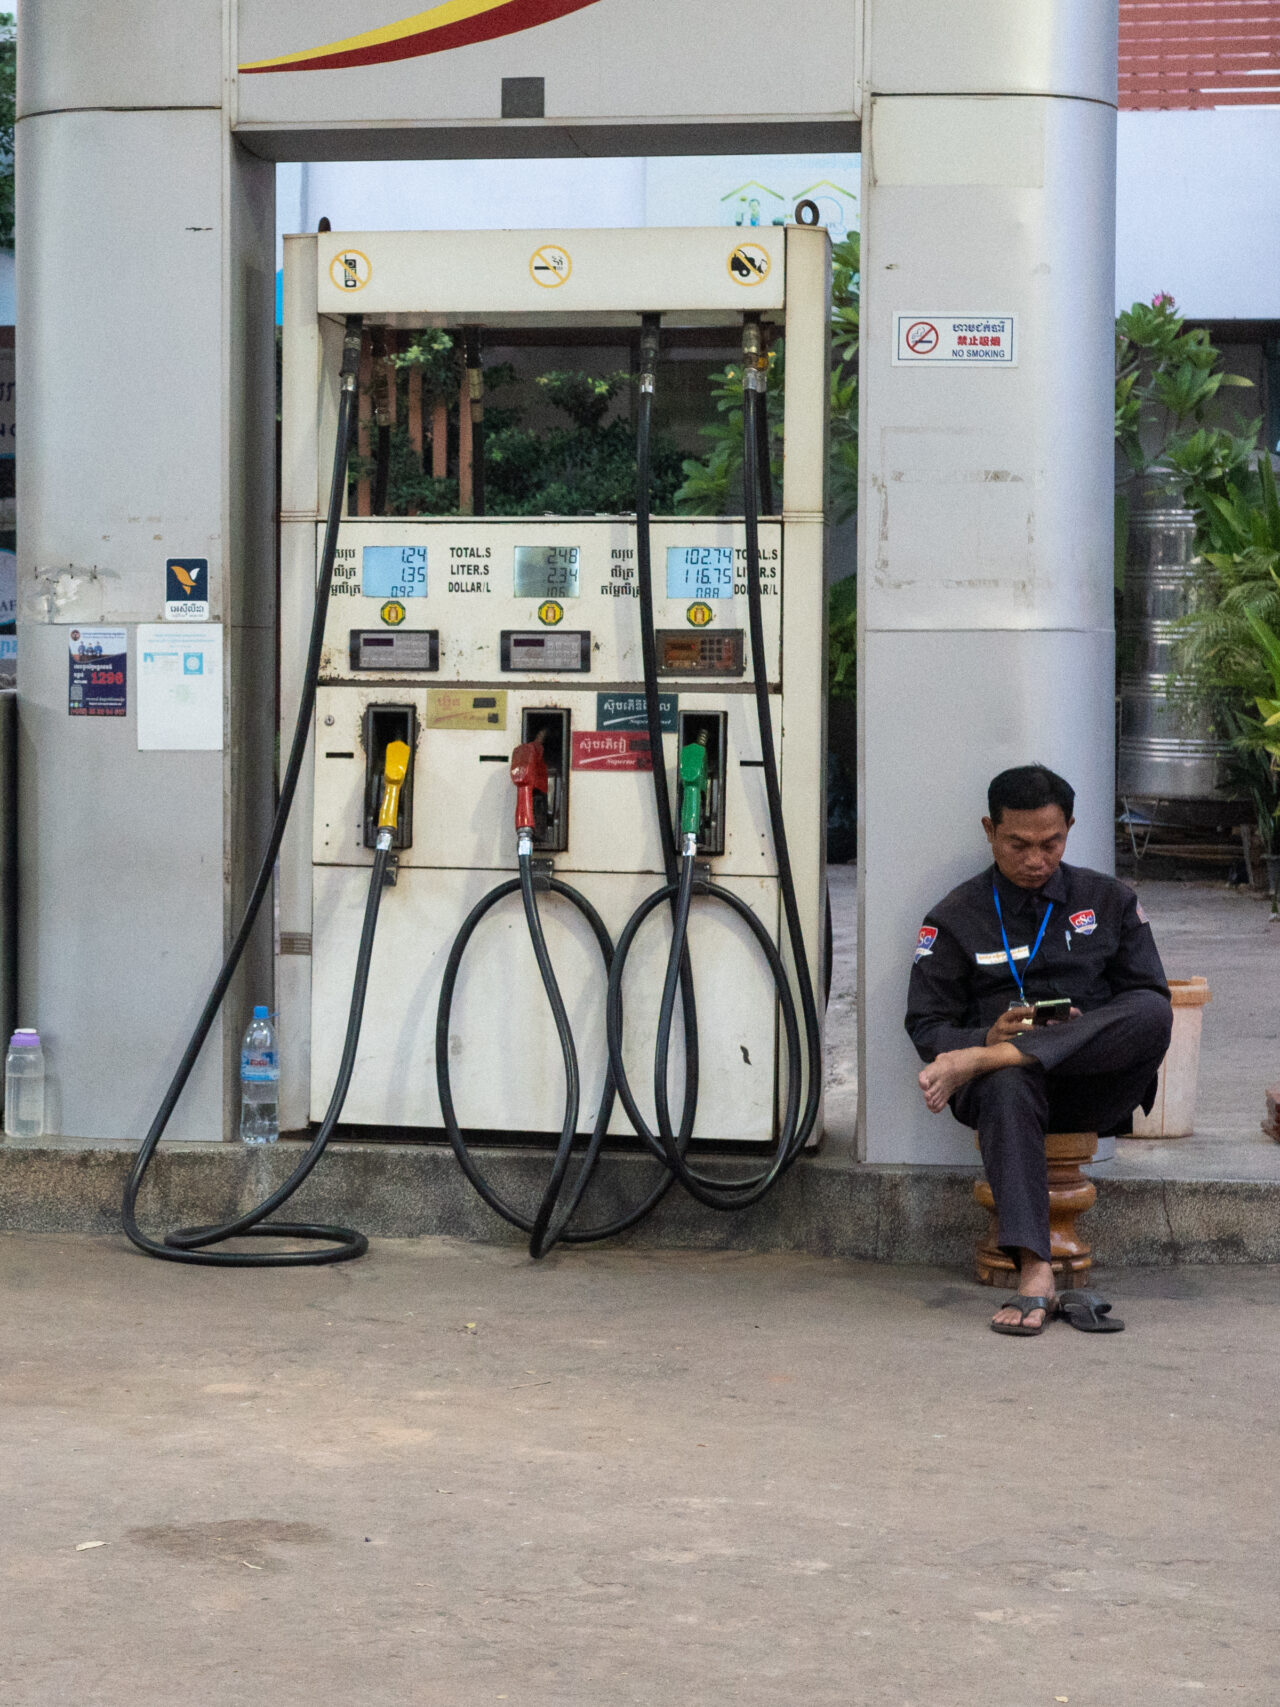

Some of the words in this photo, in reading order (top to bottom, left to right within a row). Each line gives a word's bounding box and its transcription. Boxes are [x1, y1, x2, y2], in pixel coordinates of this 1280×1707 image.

[952, 350, 964, 358] NO
[966, 350, 1005, 358] SMOKING
[449, 547, 491, 558] TOTAL.S
[686, 548, 732, 565] 102.74
[735, 549, 778, 560] TOAL.S
[451, 564, 490, 576] LITER.S
[736, 567, 777, 578] LIR.S
[685, 568, 732, 584] 116.75
[448, 582, 491, 593] DOLLAR/L
